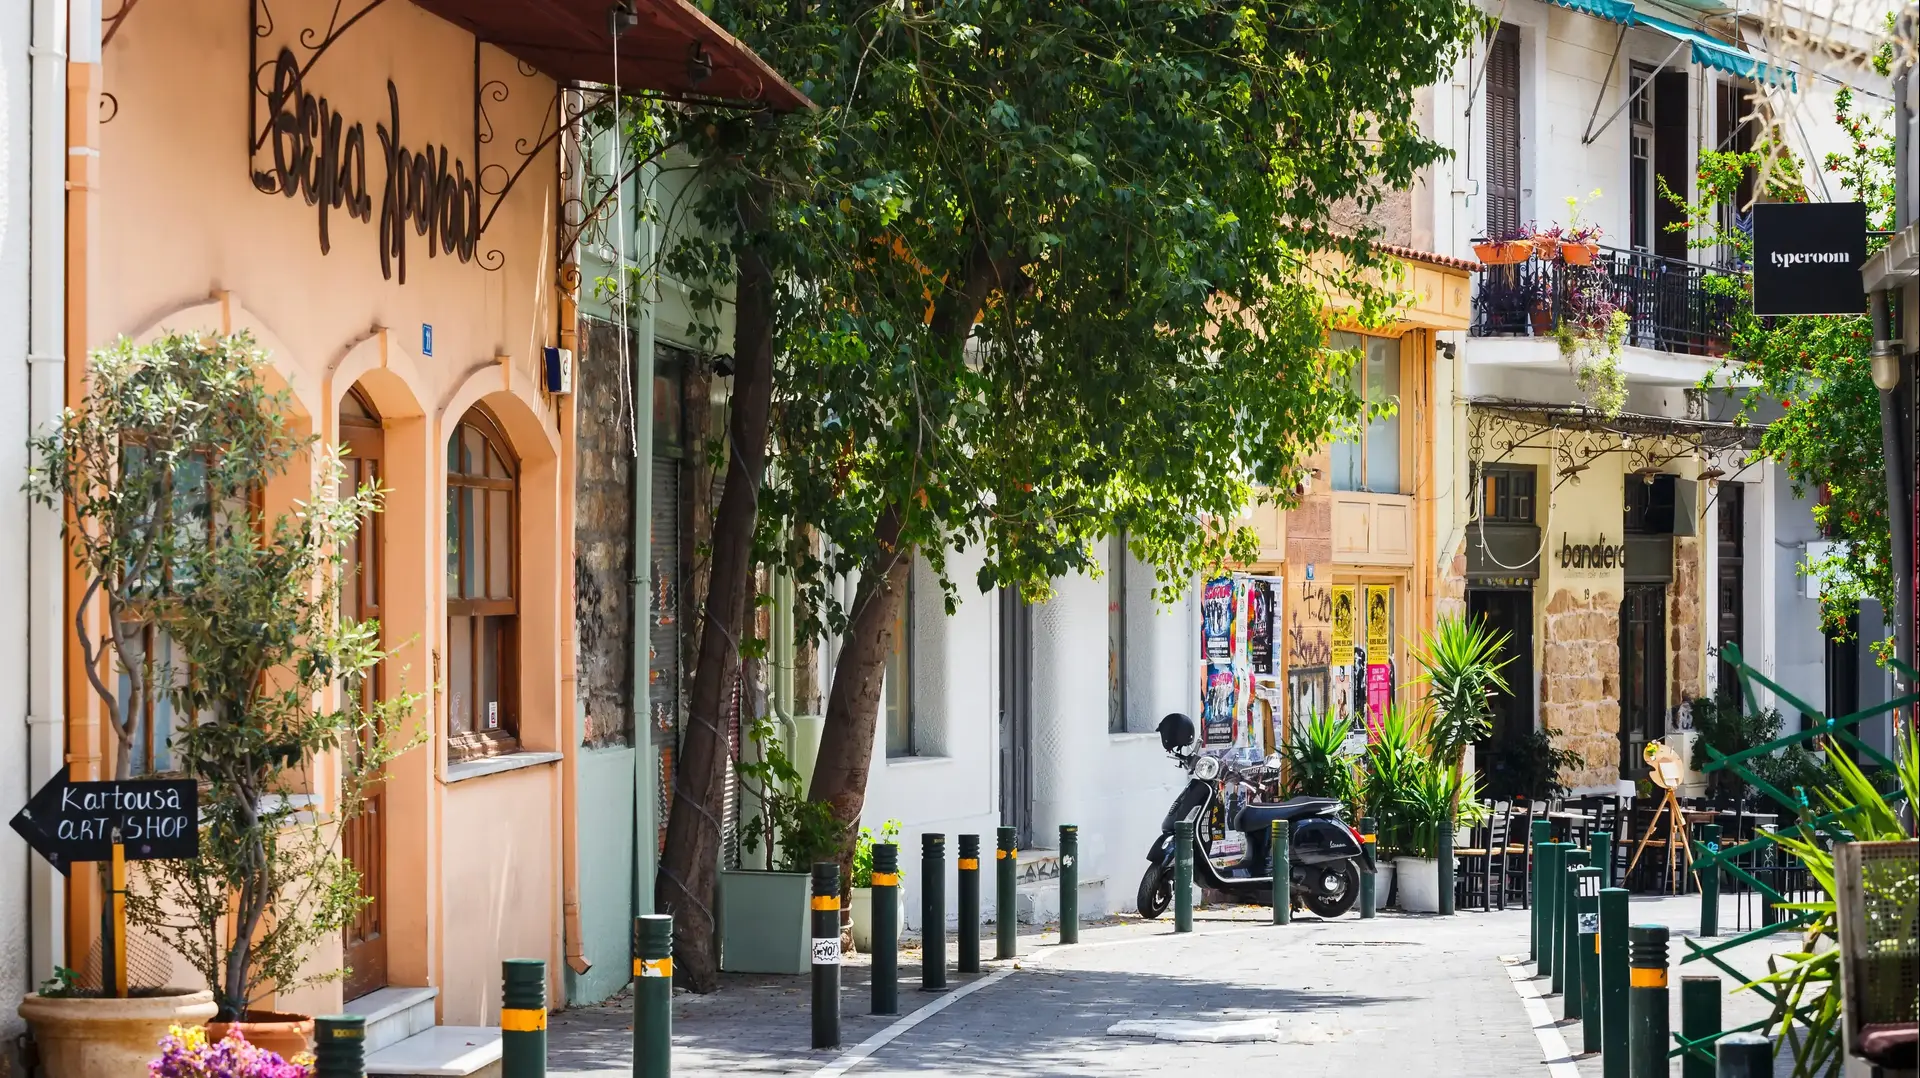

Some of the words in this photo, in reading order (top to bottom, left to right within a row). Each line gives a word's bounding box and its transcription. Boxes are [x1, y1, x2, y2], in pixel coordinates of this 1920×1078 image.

[1770, 250, 1850, 268] typeroom
[1583, 588, 1590, 600] 19
[61, 785, 182, 812] Kartousa
[126, 815, 189, 840] SHOP
